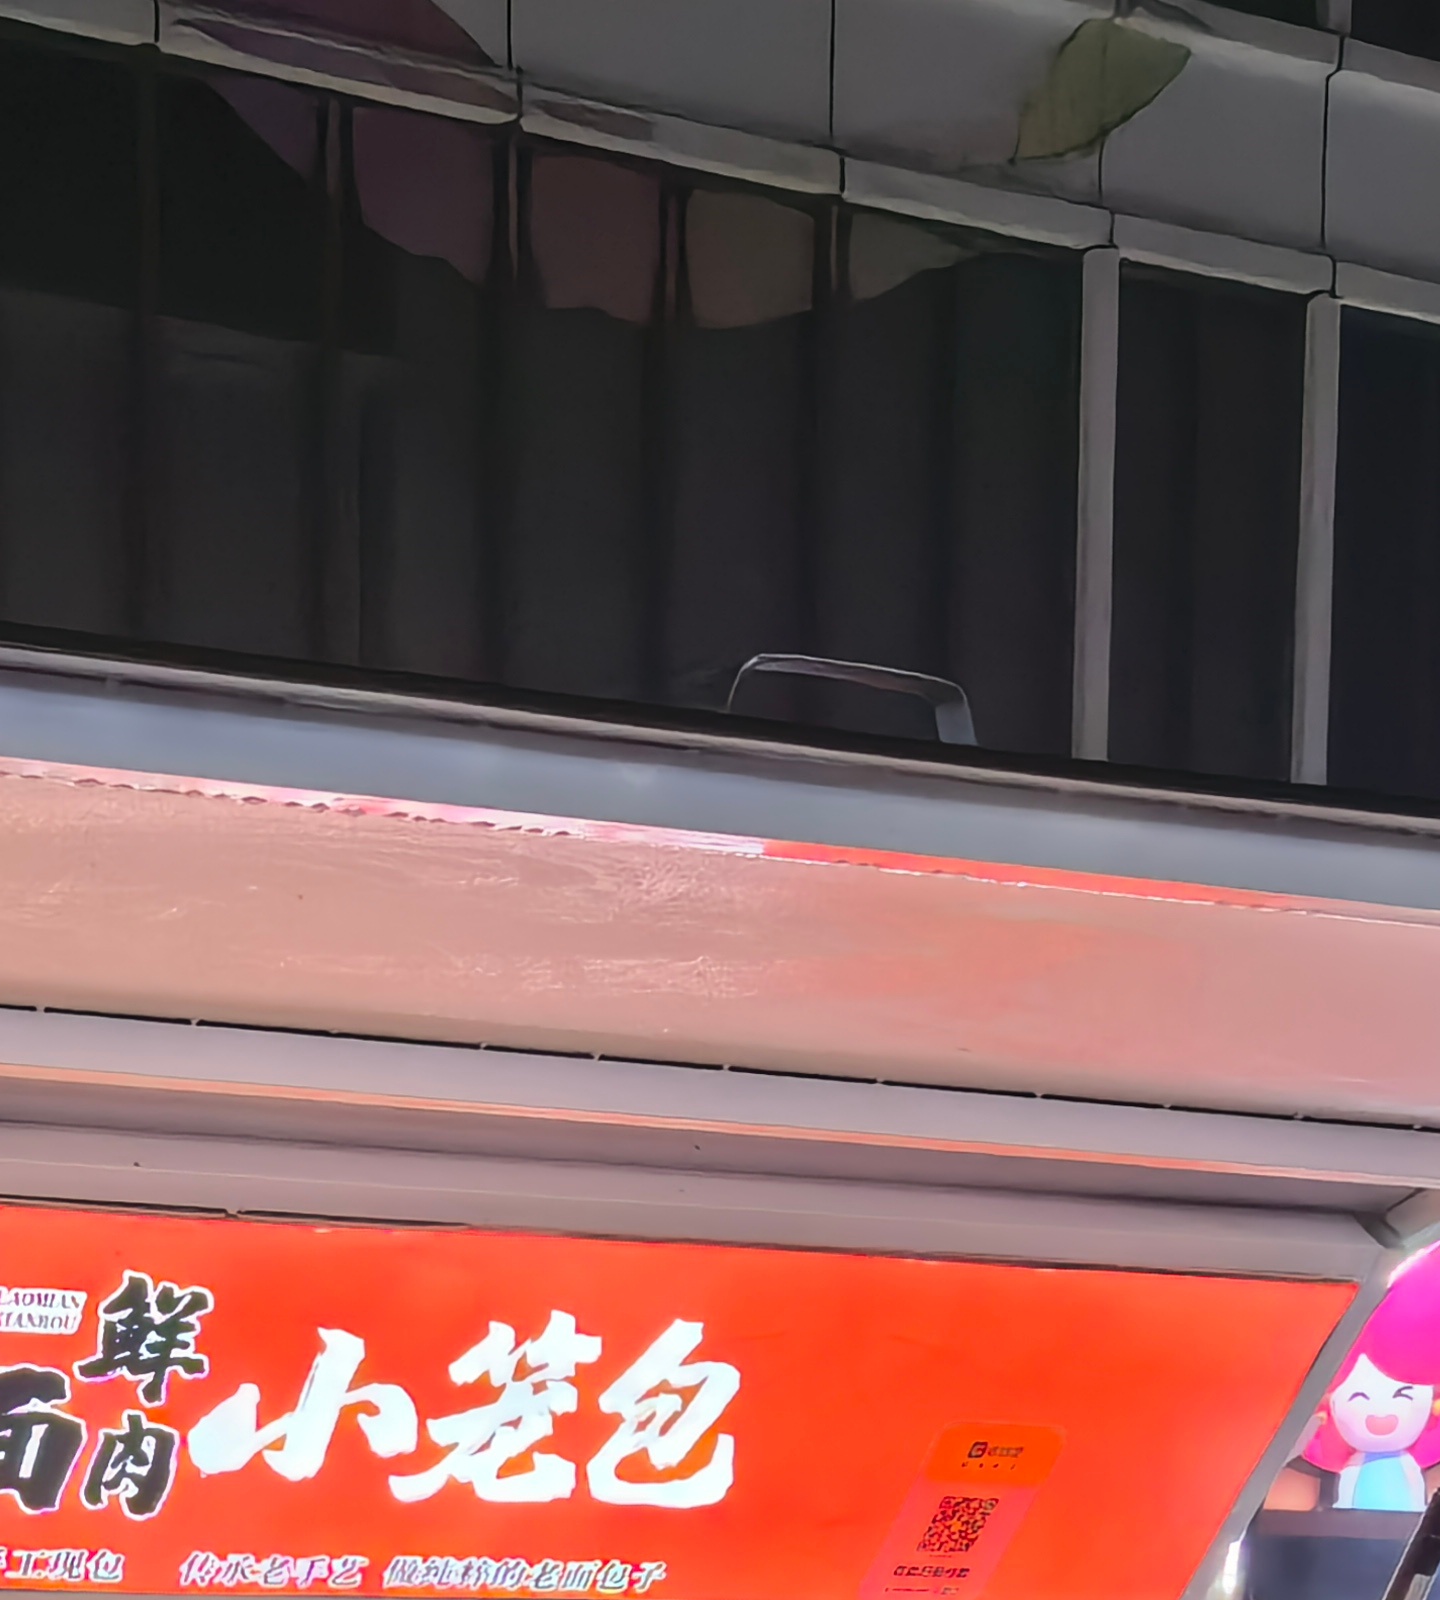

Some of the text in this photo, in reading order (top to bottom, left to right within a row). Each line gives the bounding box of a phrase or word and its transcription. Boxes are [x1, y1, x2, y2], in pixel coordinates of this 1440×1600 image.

[180, 1550, 369, 1587] 传承老手艺
